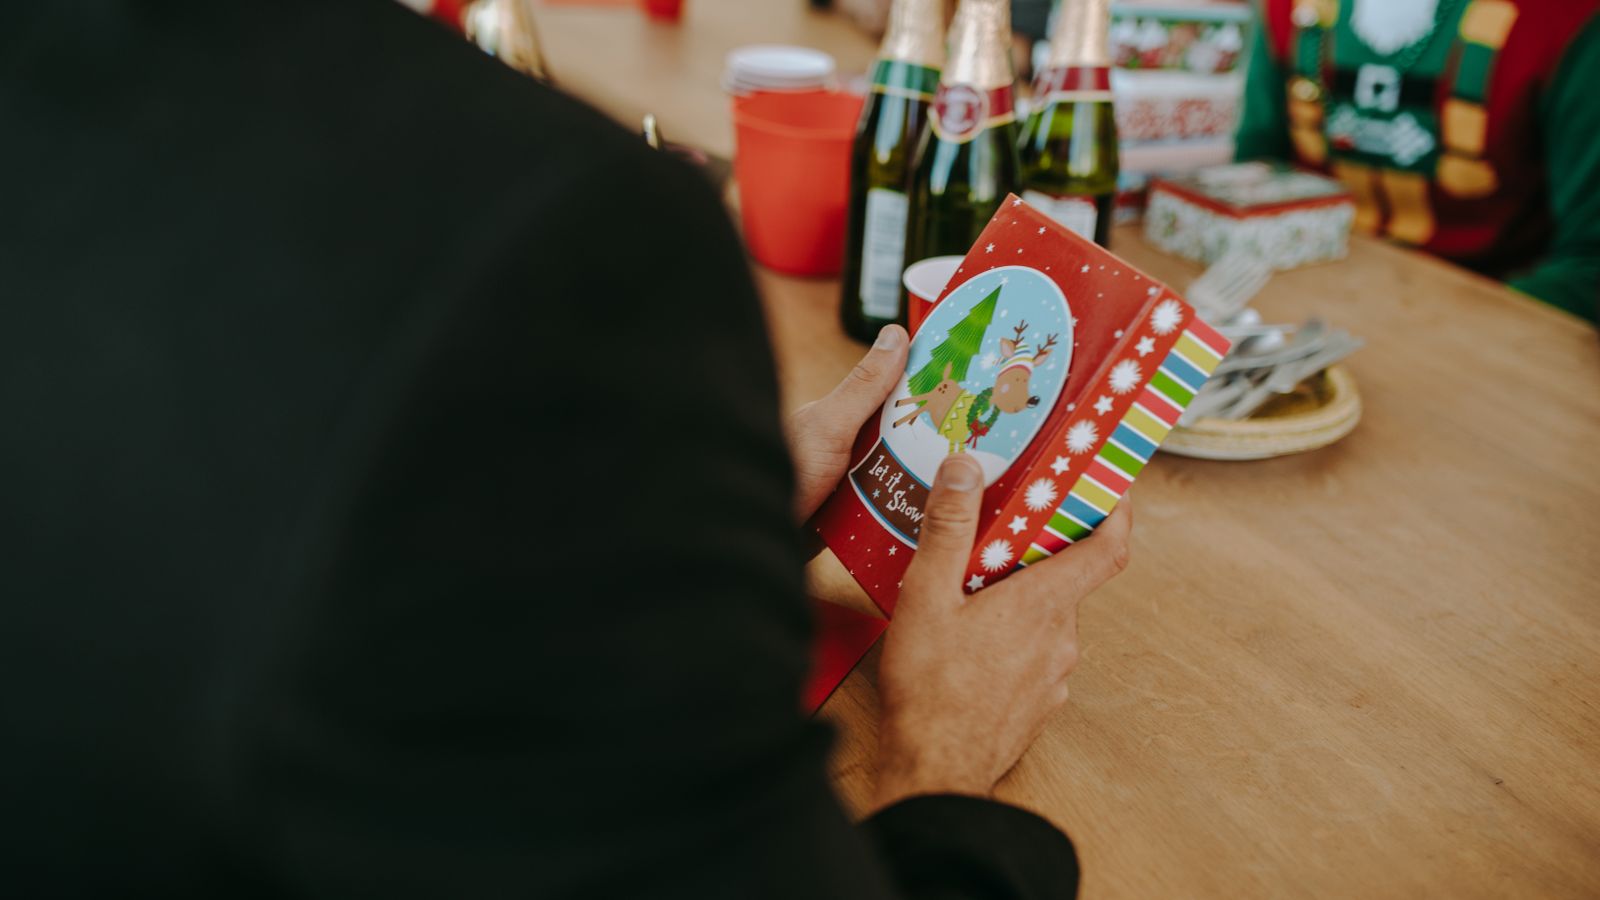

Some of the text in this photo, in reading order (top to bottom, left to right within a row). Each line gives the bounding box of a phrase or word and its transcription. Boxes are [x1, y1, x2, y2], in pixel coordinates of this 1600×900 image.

[868, 455, 924, 522] let it Snow
